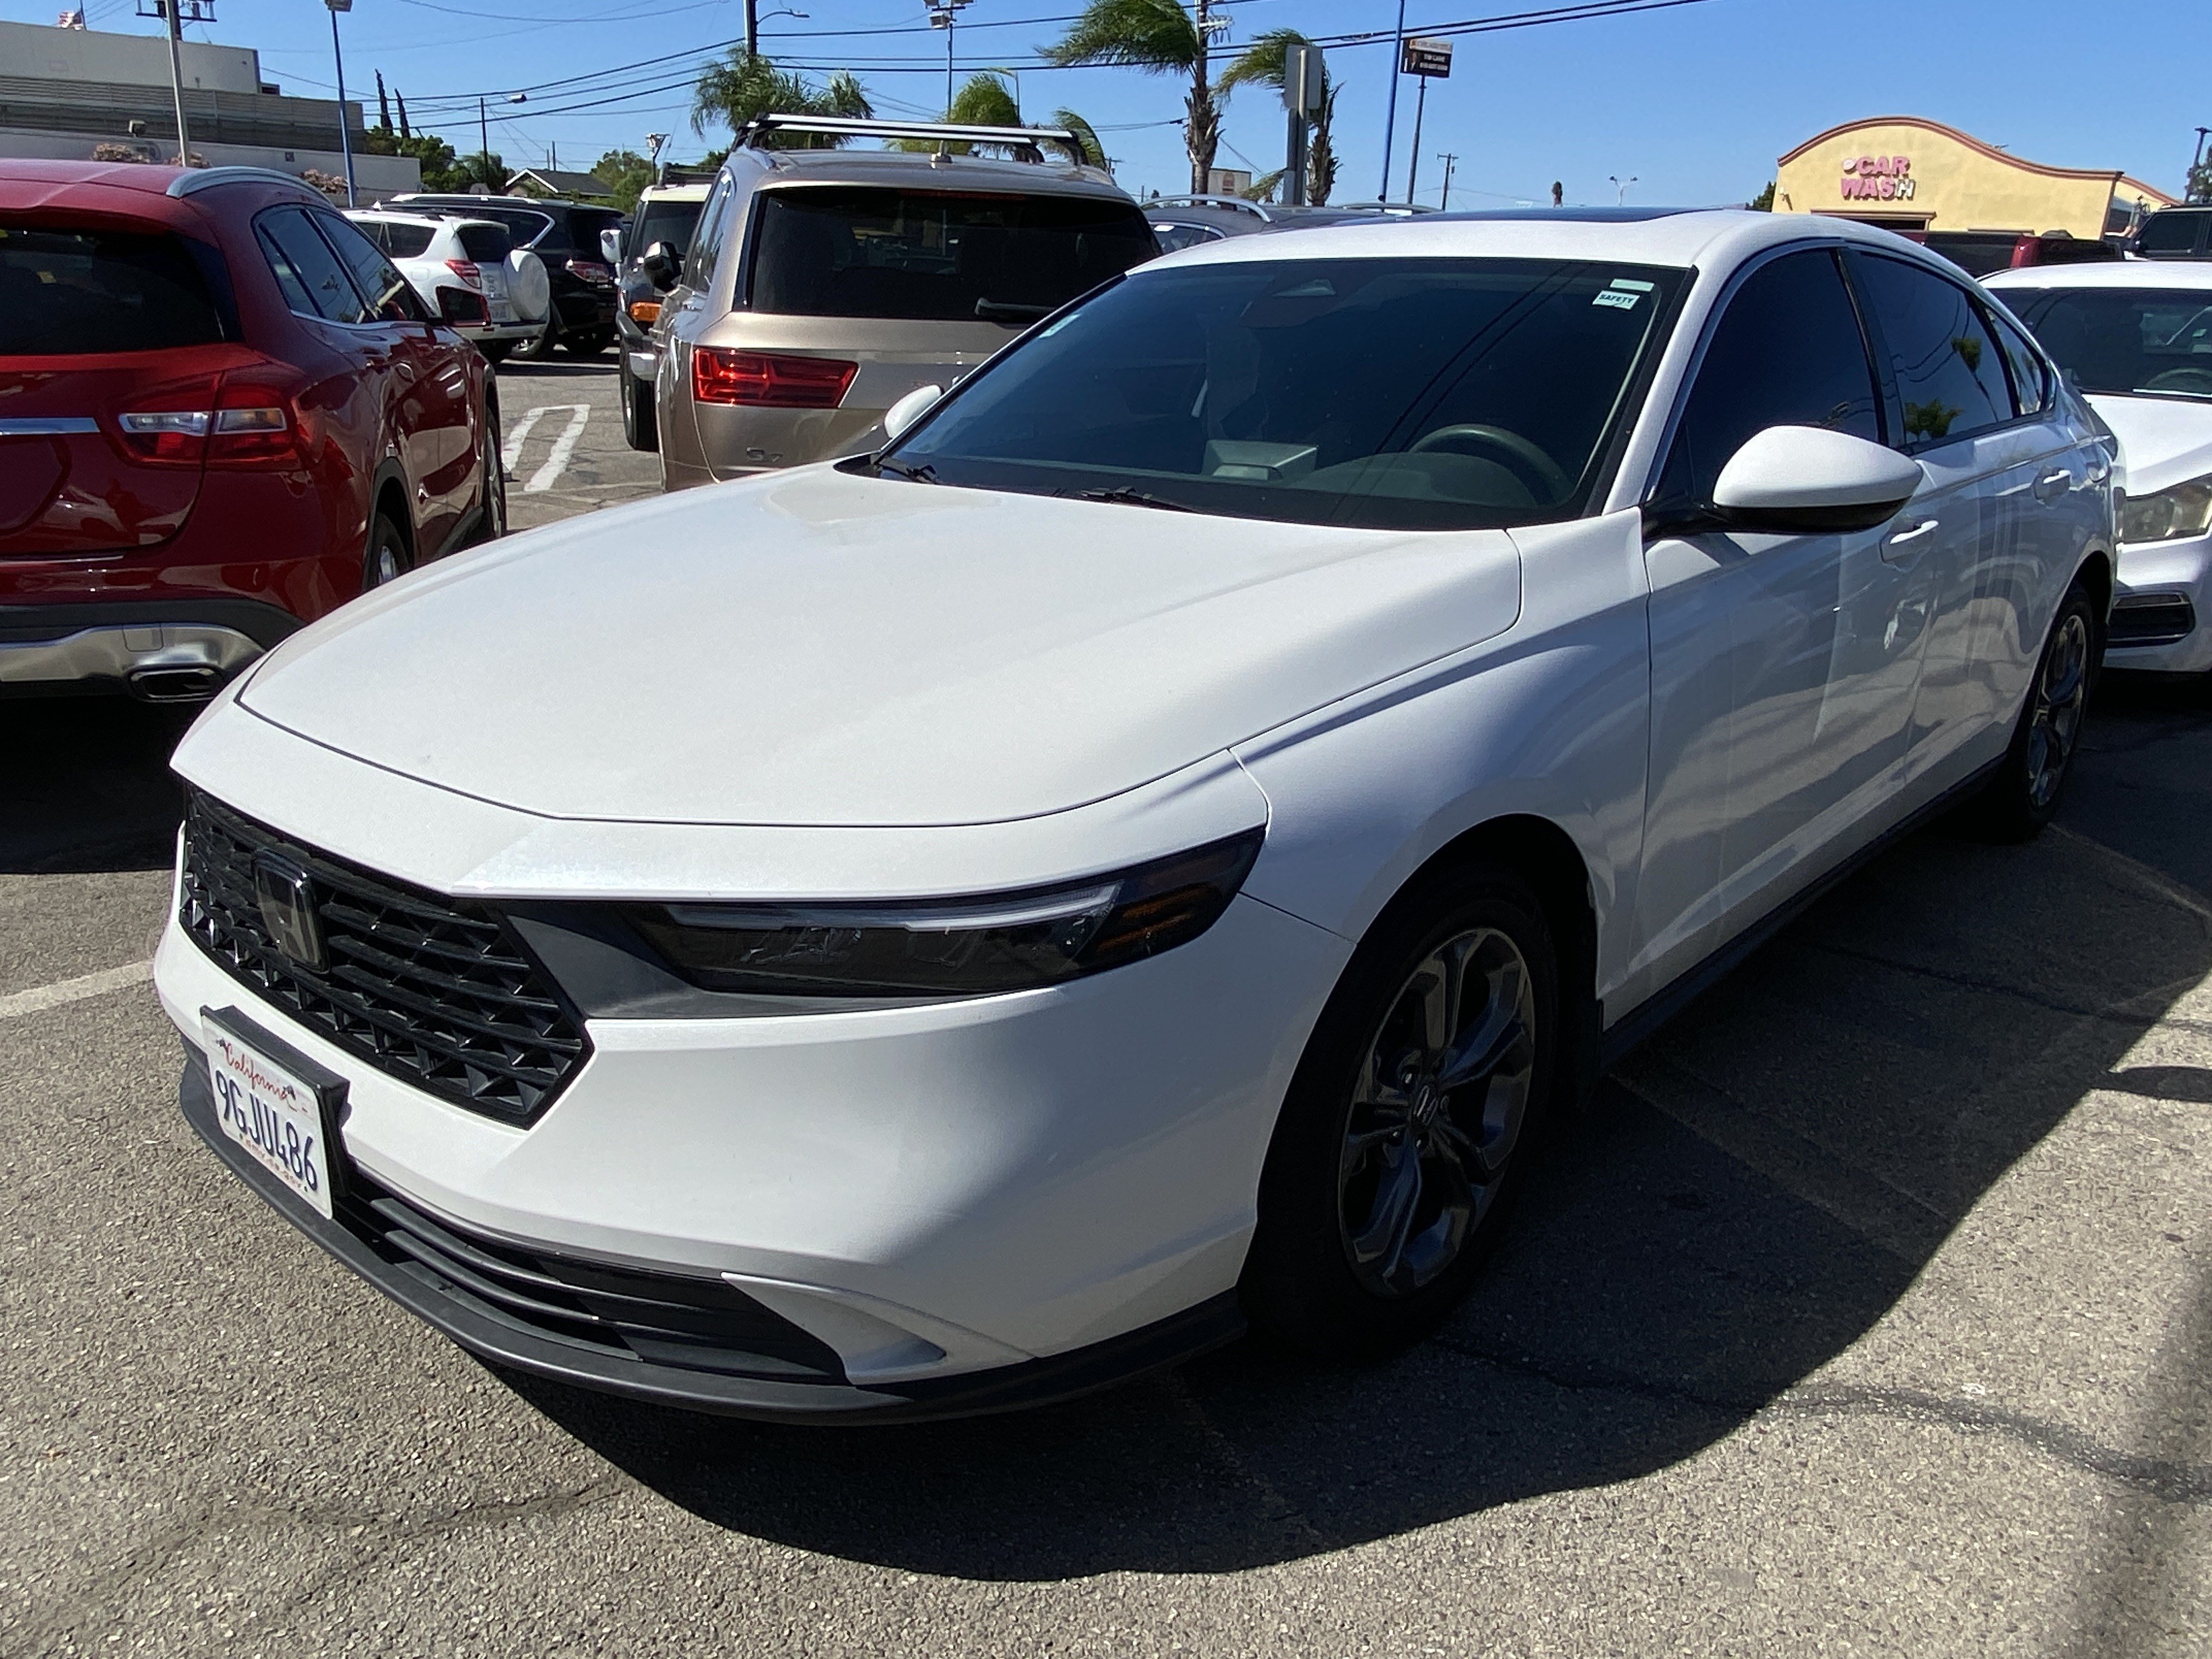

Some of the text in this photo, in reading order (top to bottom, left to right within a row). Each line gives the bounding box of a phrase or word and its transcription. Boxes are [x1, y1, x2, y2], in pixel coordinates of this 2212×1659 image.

[1856, 156, 1910, 177] CAR
[1841, 177, 1916, 199] WASH
[1599, 294, 1634, 303] SAFETY
[223, 1041, 288, 1101] California
[215, 1070, 318, 1192] 9GJU486
